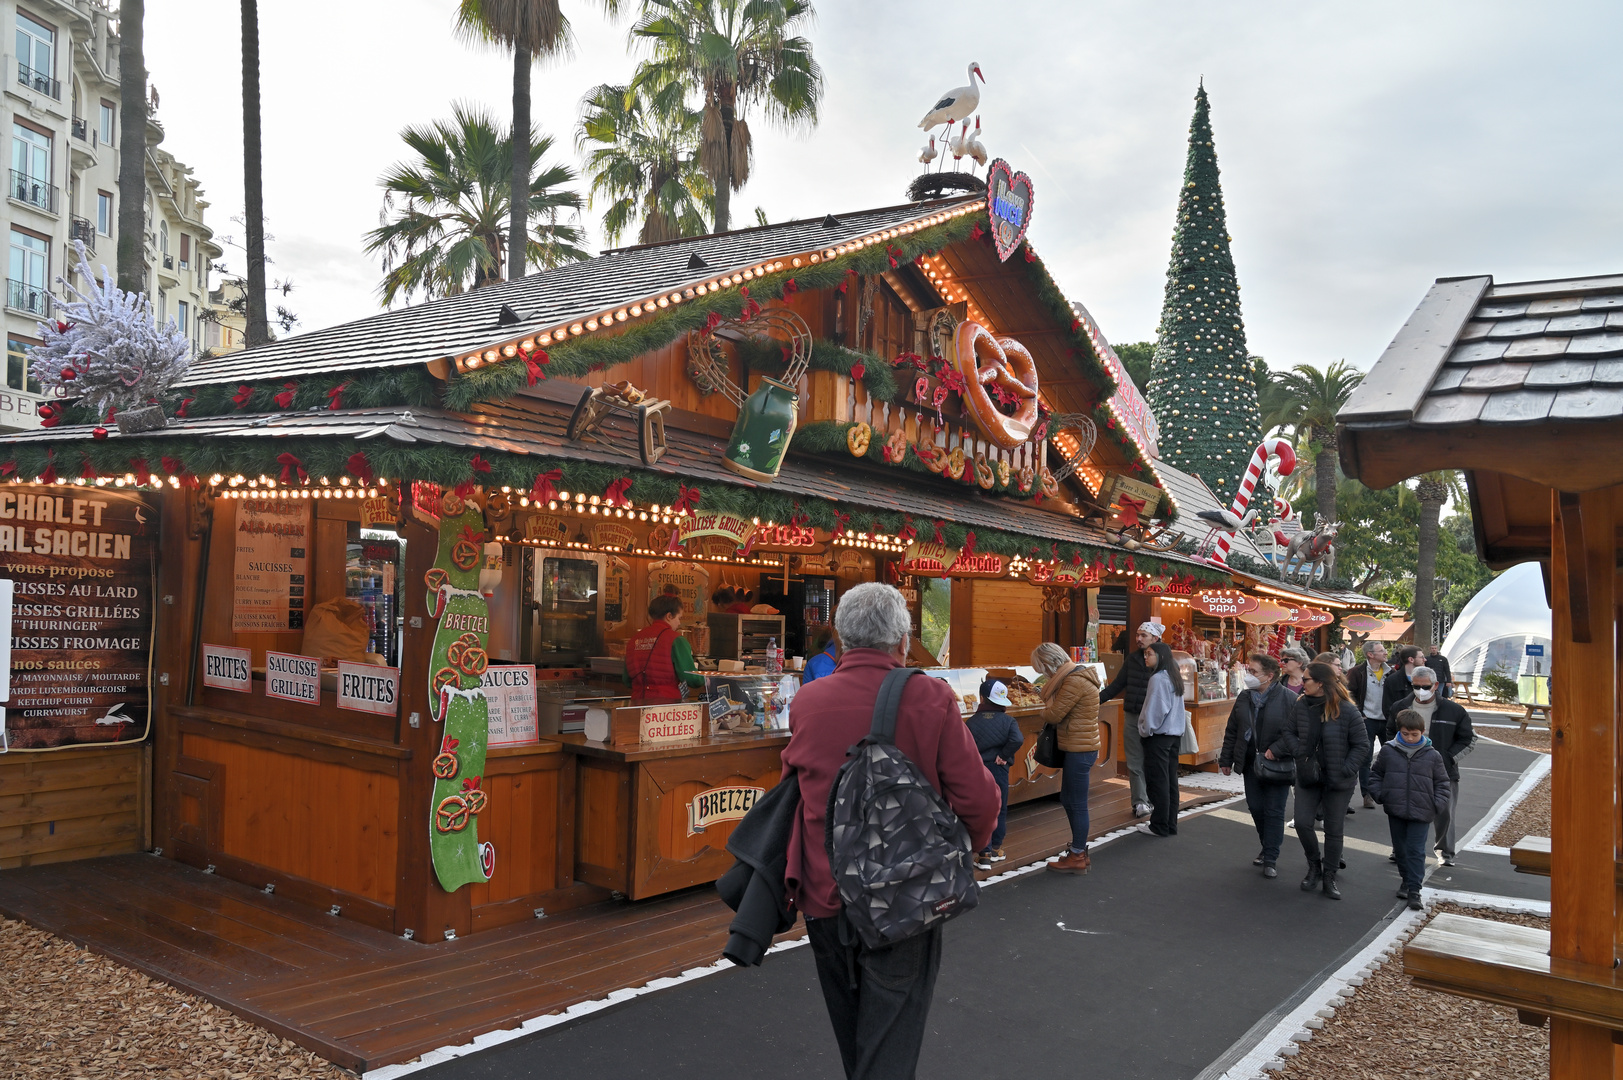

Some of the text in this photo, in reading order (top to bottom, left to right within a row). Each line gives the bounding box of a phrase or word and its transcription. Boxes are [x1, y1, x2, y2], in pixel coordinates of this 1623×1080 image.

[994, 196, 1023, 227] NICE
[0, 492, 107, 526] CHALET
[243, 500, 303, 516] CHALET
[239, 520, 305, 536] ALSACIEN
[535, 515, 559, 528] PIZZA
[680, 514, 718, 536] SAUCISSE
[532, 525, 566, 542] BAGUETTE
[599, 532, 629, 546] BAGUETTE
[0, 525, 131, 560] ALSACIEN
[917, 543, 947, 559] FRITES
[7, 563, 114, 579] vous propose
[249, 562, 293, 572] SAUCISSES
[12, 582, 138, 598] CISSES AU LARD
[1202, 594, 1233, 604] Barbe
[11, 603, 140, 619] CISSES GRILLÉES
[1209, 604, 1237, 613] PAPA
[14, 620, 103, 631] "THURINGER"
[444, 613, 489, 634] BRETZEL
[10, 636, 140, 650] CISSES FROMAGE
[14, 661, 100, 670] nos sauces
[206, 654, 247, 681] FRITES
[269, 656, 318, 677] SAUCISSE
[22, 674, 83, 682] MAYONNAISE
[91, 673, 140, 681] MOUTARDE
[9, 685, 127, 695] TARDE LUXEMBOURGEOISE
[271, 678, 315, 700] GRILLÉE
[342, 673, 394, 704] FRITES
[17, 698, 62, 706] KETCHUP
[509, 694, 533, 702] BARBECUE
[23, 708, 88, 717] CURRYWURST
[510, 706, 532, 714] KETCHUP
[644, 709, 698, 724] SAUCISSES
[509, 725, 535, 733] MOUTARDE
[648, 722, 695, 738] GRILLÉES
[935, 898, 956, 912] EASTPAK
